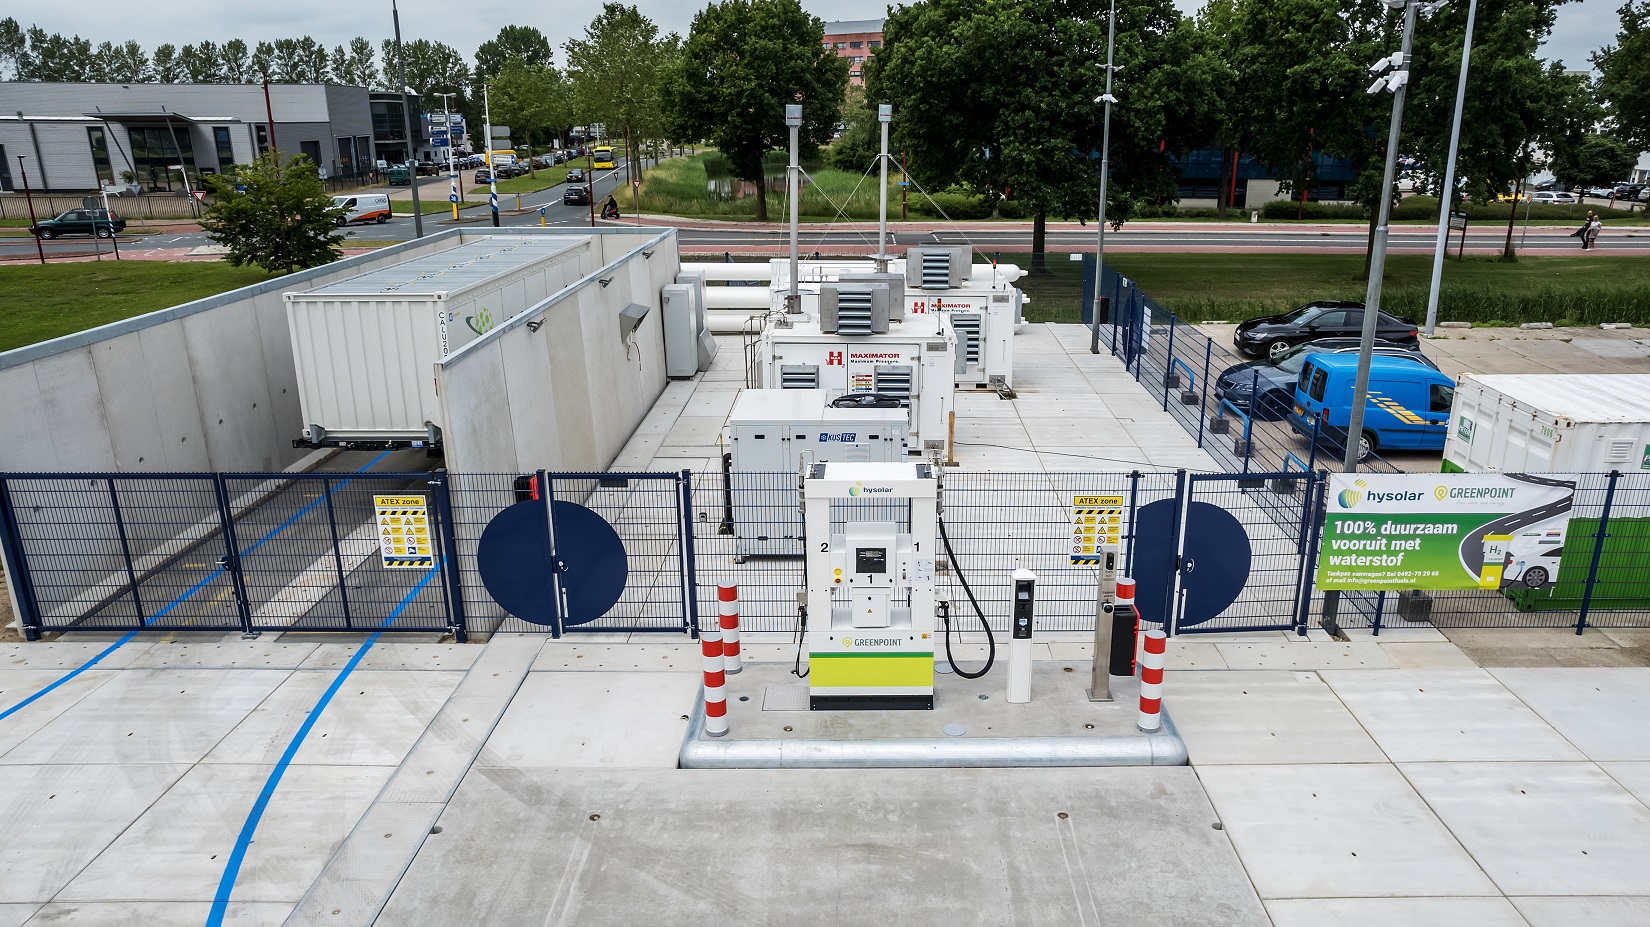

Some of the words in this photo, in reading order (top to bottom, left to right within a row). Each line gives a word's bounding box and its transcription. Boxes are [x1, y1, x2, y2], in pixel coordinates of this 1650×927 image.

[863, 486, 894, 494] hysolar
[1366, 490, 1425, 503] hysolar
[1449, 487, 1516, 499] GREENPOINT
[1334, 520, 1377, 534] 100%
[1380, 520, 1458, 535] duurzaam
[820, 542, 829, 553] 2
[913, 541, 920, 552] 1
[1331, 536, 1387, 551] vooruit
[1390, 537, 1421, 551] met
[1329, 552, 1404, 567] waterstof
[867, 573, 873, 584] 1
[1347, 577, 1417, 585] info@greenpointfuels.nl
[854, 638, 903, 647] GREENPOINT
